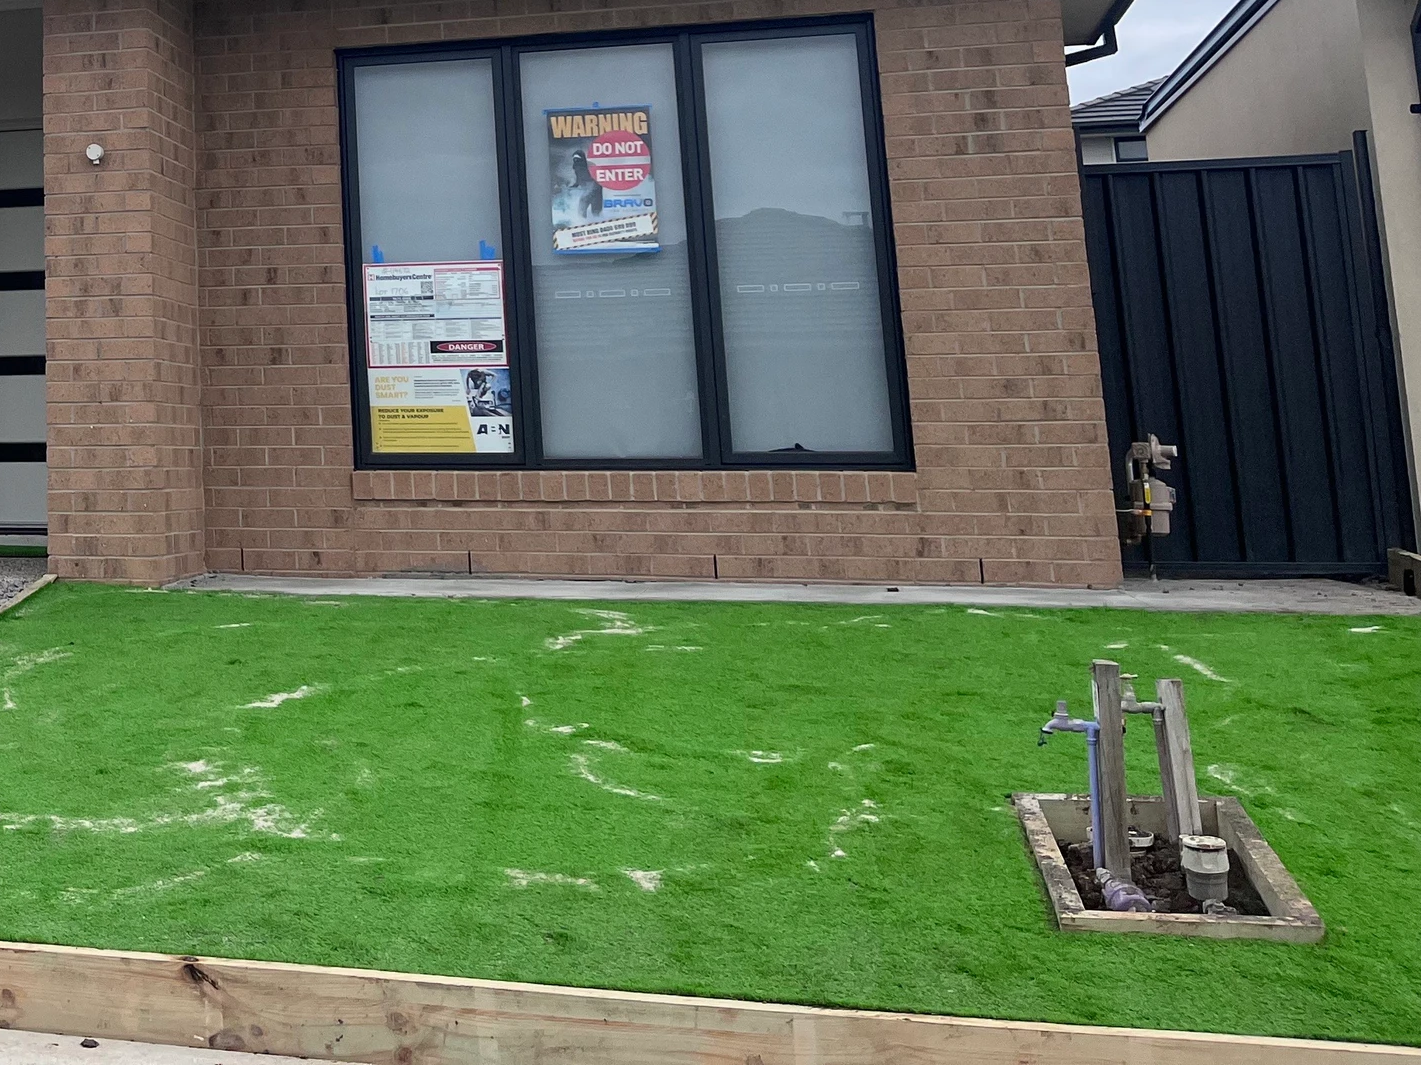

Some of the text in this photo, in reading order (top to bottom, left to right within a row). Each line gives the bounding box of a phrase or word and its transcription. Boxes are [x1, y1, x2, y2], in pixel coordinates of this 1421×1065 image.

[550, 111, 648, 139] WARNING
[592, 141, 644, 155] DO NOT
[596, 168, 644, 182] ENTER
[603, 198, 653, 208] BRAVO
[448, 343, 485, 351] DANGER
[391, 375, 409, 383] YOU
